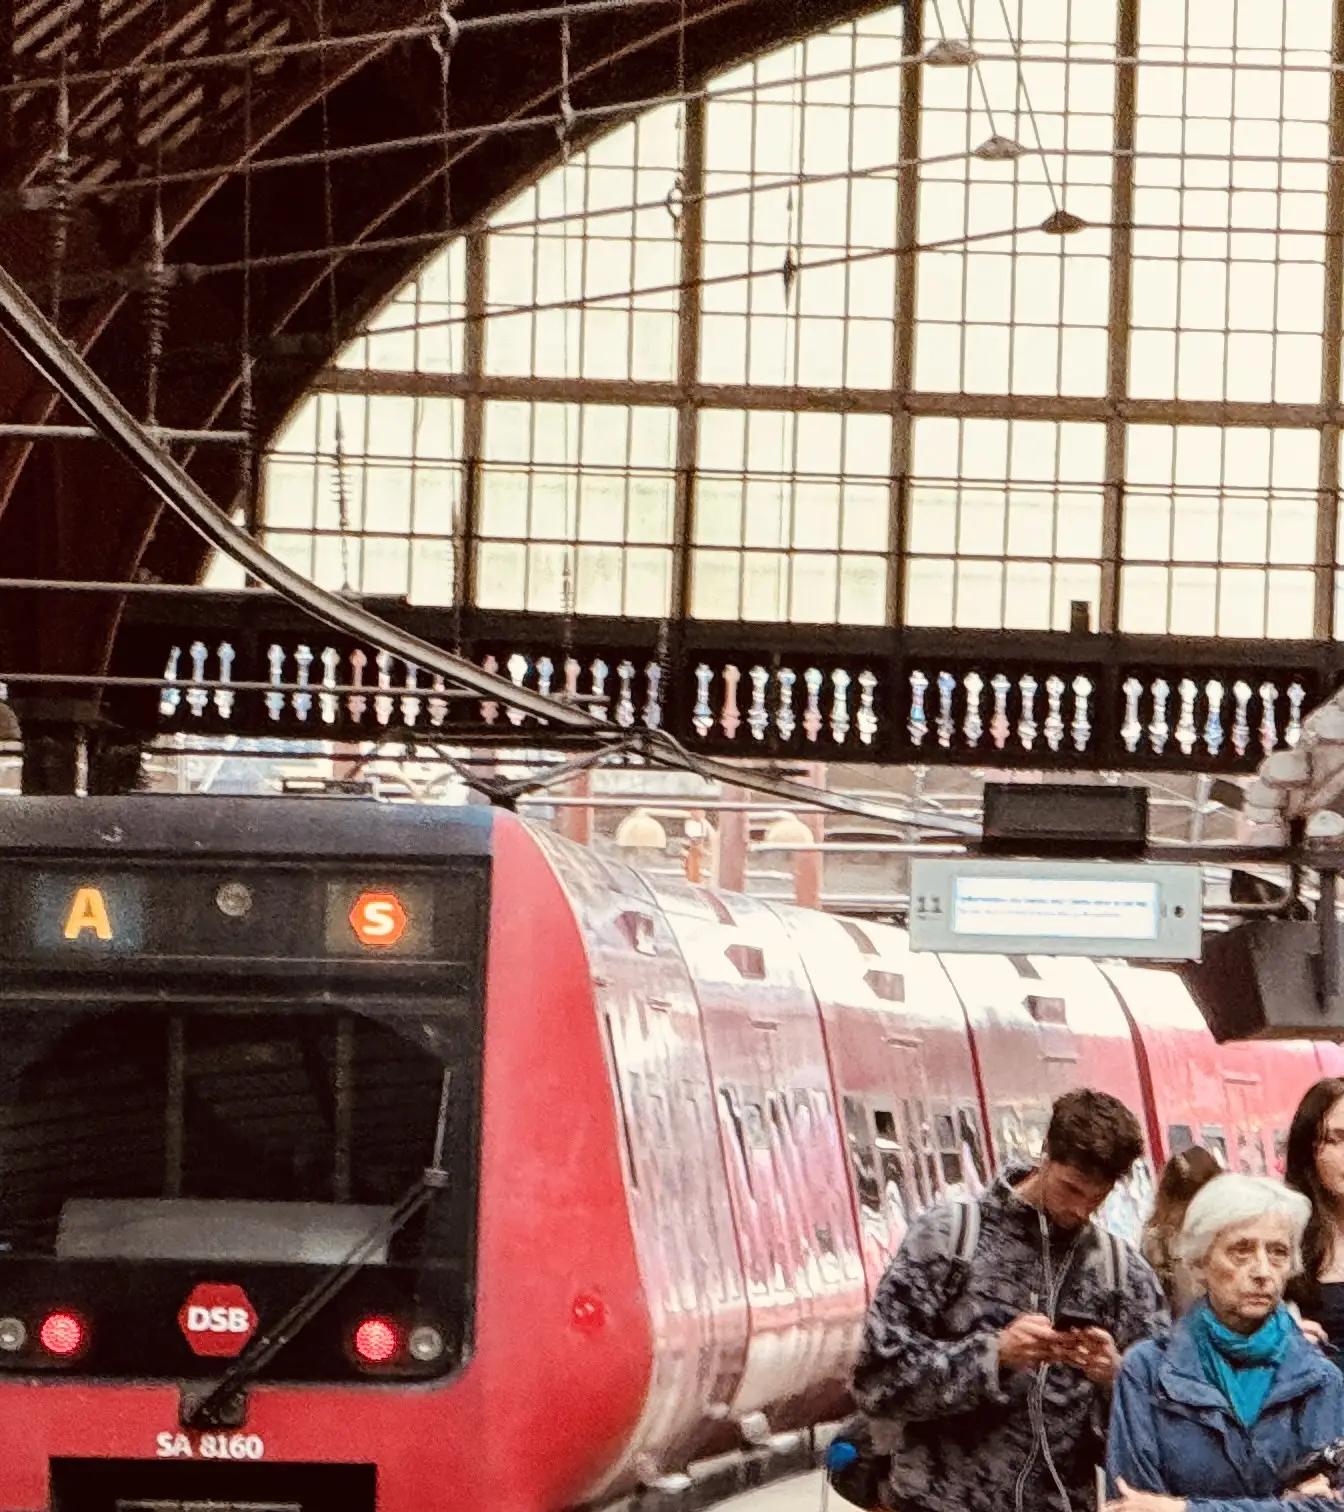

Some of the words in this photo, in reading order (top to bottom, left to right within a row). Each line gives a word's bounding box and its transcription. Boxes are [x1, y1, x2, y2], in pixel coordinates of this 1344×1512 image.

[64, 888, 113, 939] A
[362, 901, 396, 937] S
[916, 895, 943, 914] 11
[187, 1305, 250, 1333] DSB
[156, 1431, 193, 1458] SA
[199, 1433, 264, 1460] 8160
